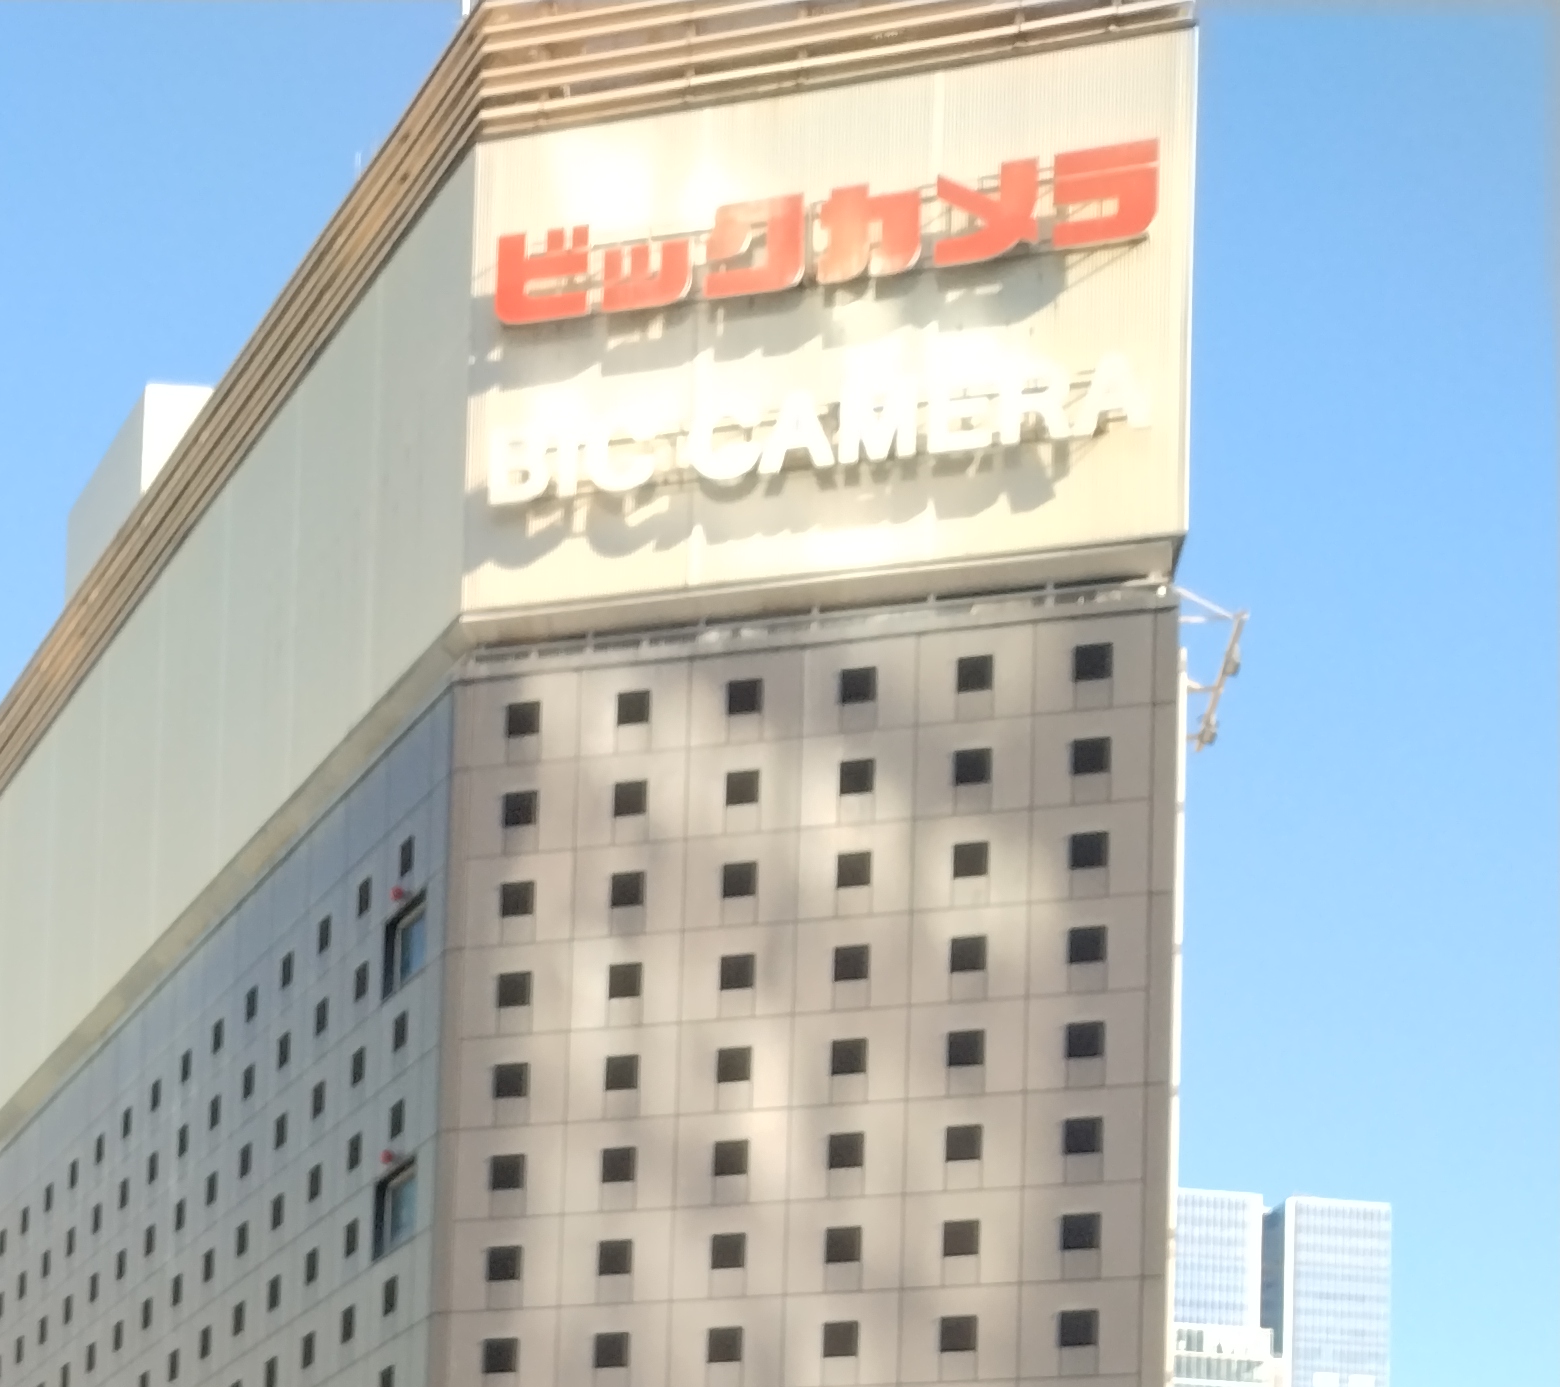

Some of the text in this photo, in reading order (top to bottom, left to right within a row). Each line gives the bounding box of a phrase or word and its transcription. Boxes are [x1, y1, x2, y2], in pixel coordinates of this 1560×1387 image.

[494, 137, 1160, 326] ビックカメラ
[486, 350, 1154, 507] BIC CAMERA
